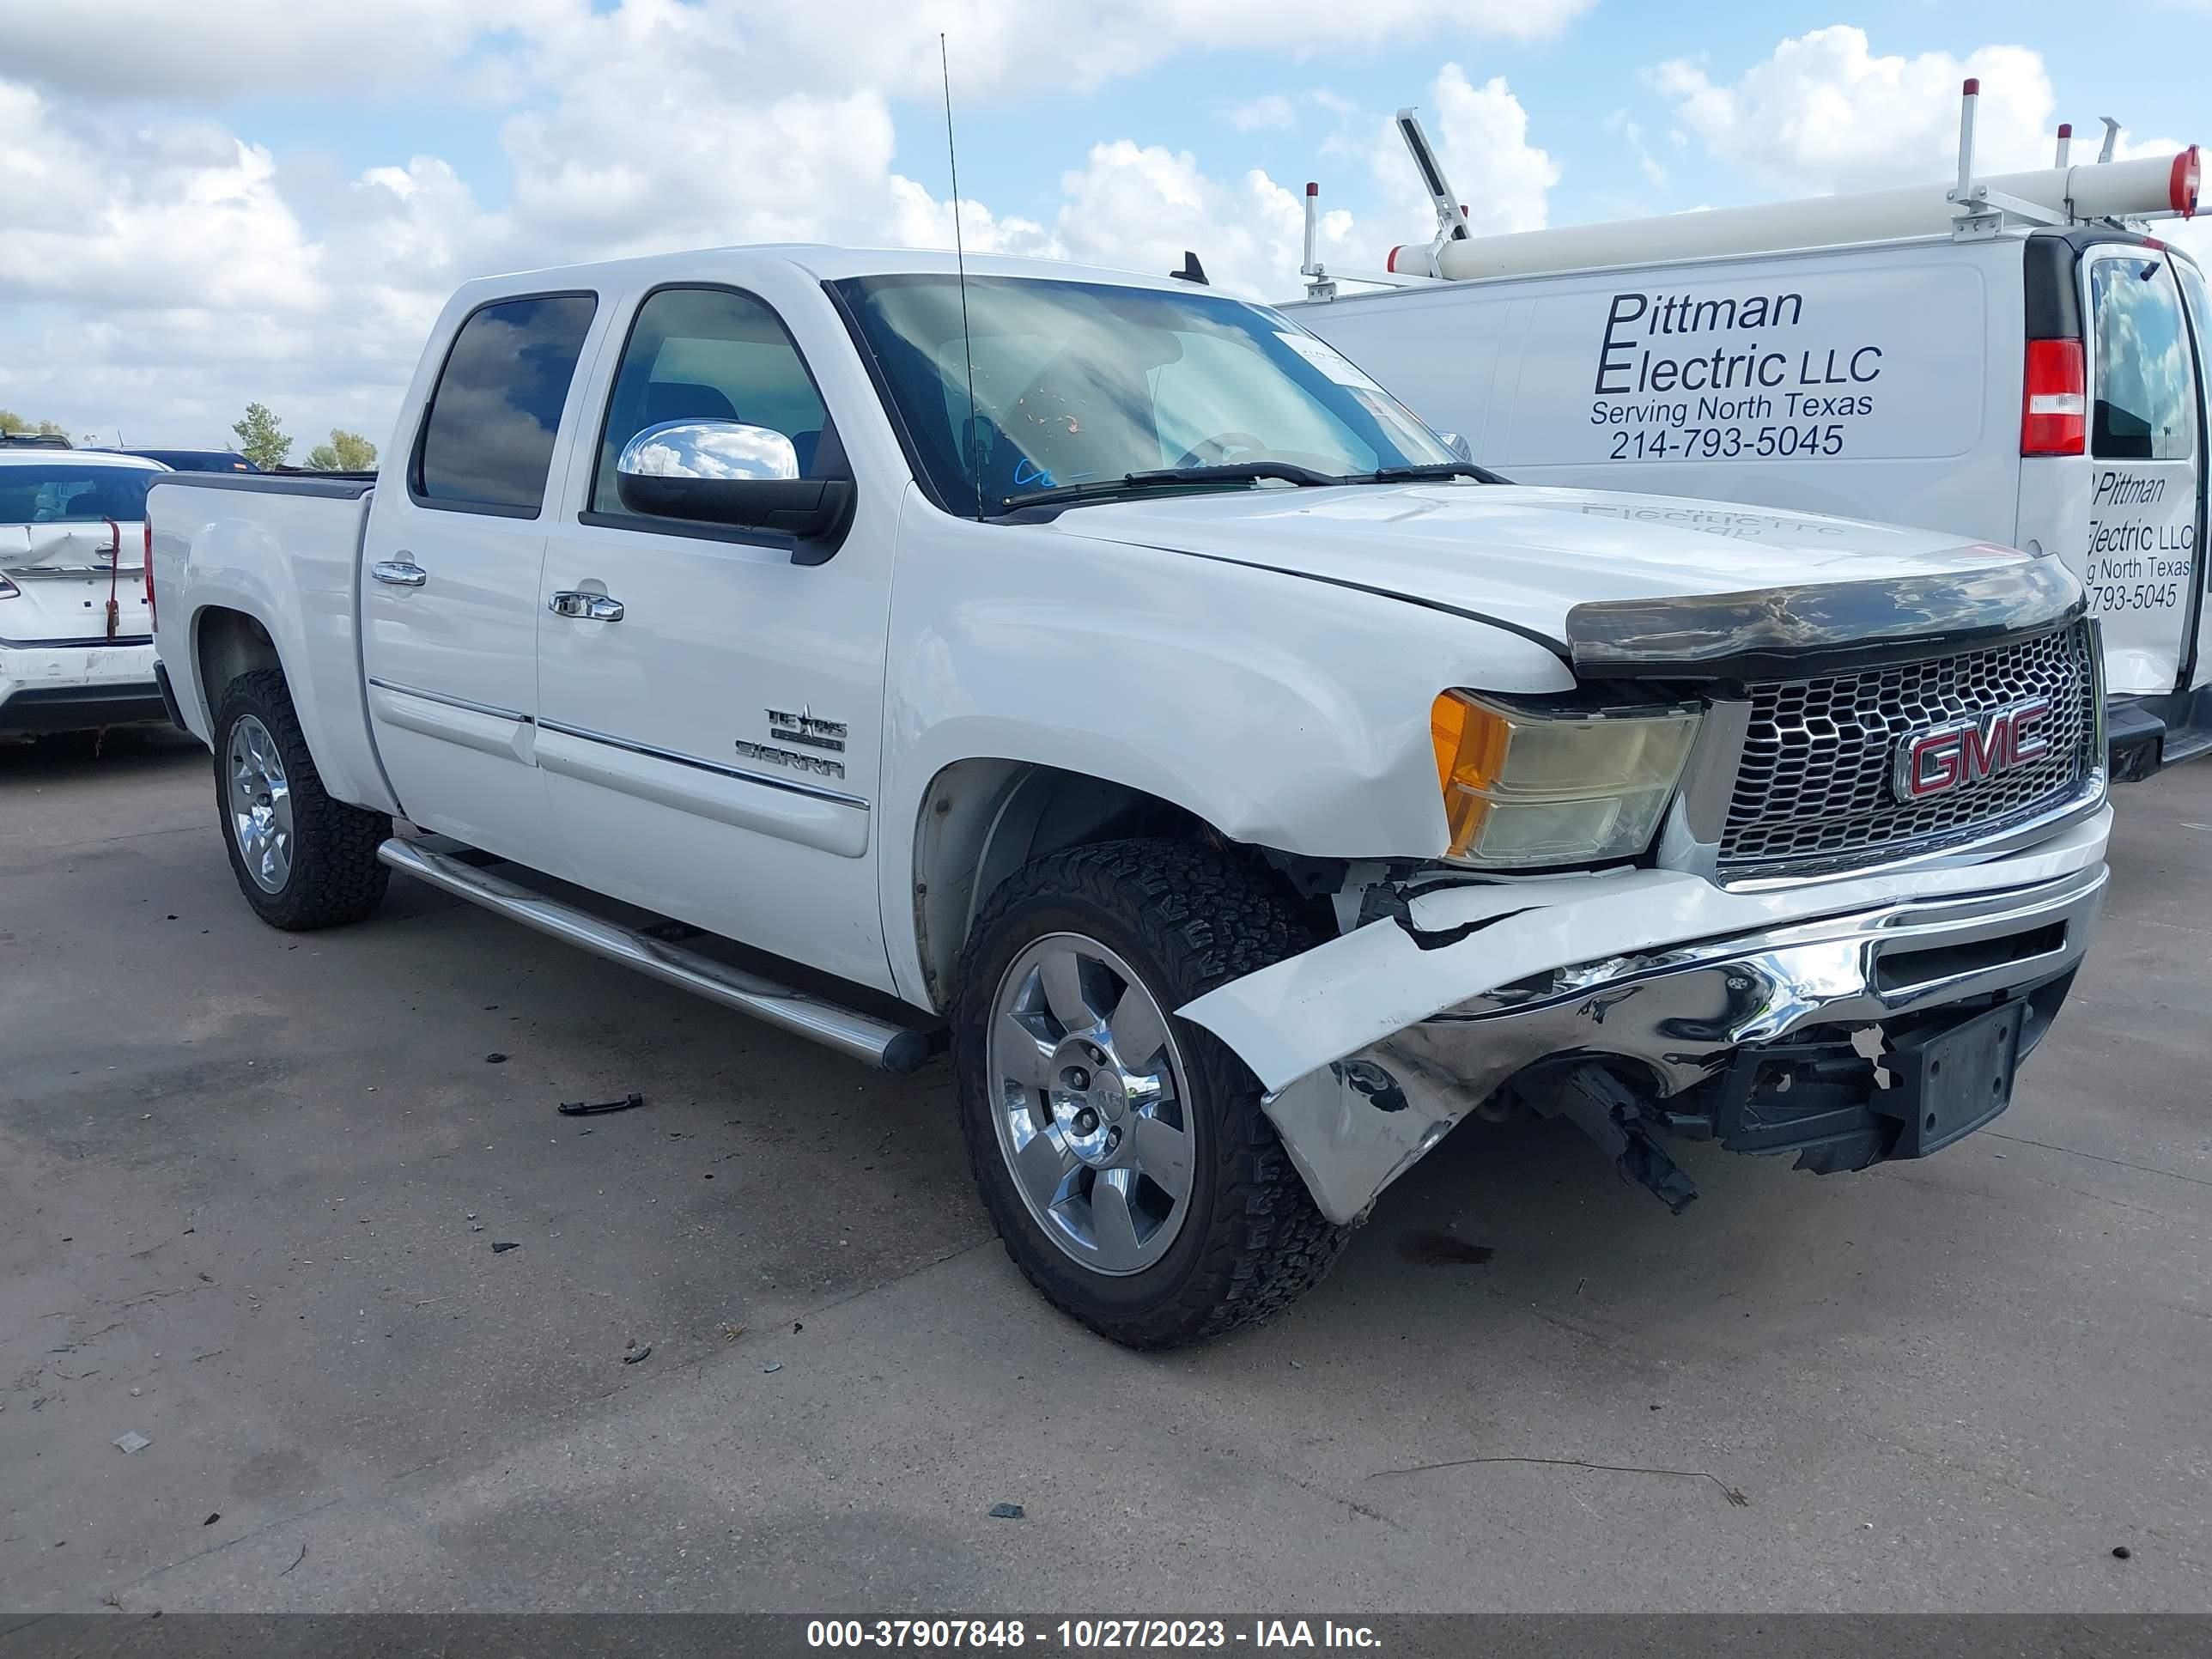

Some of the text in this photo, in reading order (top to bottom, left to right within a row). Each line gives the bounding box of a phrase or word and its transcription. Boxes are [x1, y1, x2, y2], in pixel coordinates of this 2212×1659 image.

[1603, 292, 1802, 343] Pittman
[1595, 341, 1883, 394] Electric LLC
[1590, 392, 1873, 428] Serving North Texas
[1609, 424, 1844, 459] 214-793-5045
[2093, 471, 2166, 506] Pittman
[2159, 525, 2193, 550] LLC
[2100, 557, 2142, 580] North
[2148, 556, 2191, 578] Texas
[735, 738, 845, 780] SIERRA
[1910, 697, 2050, 798] GMC
